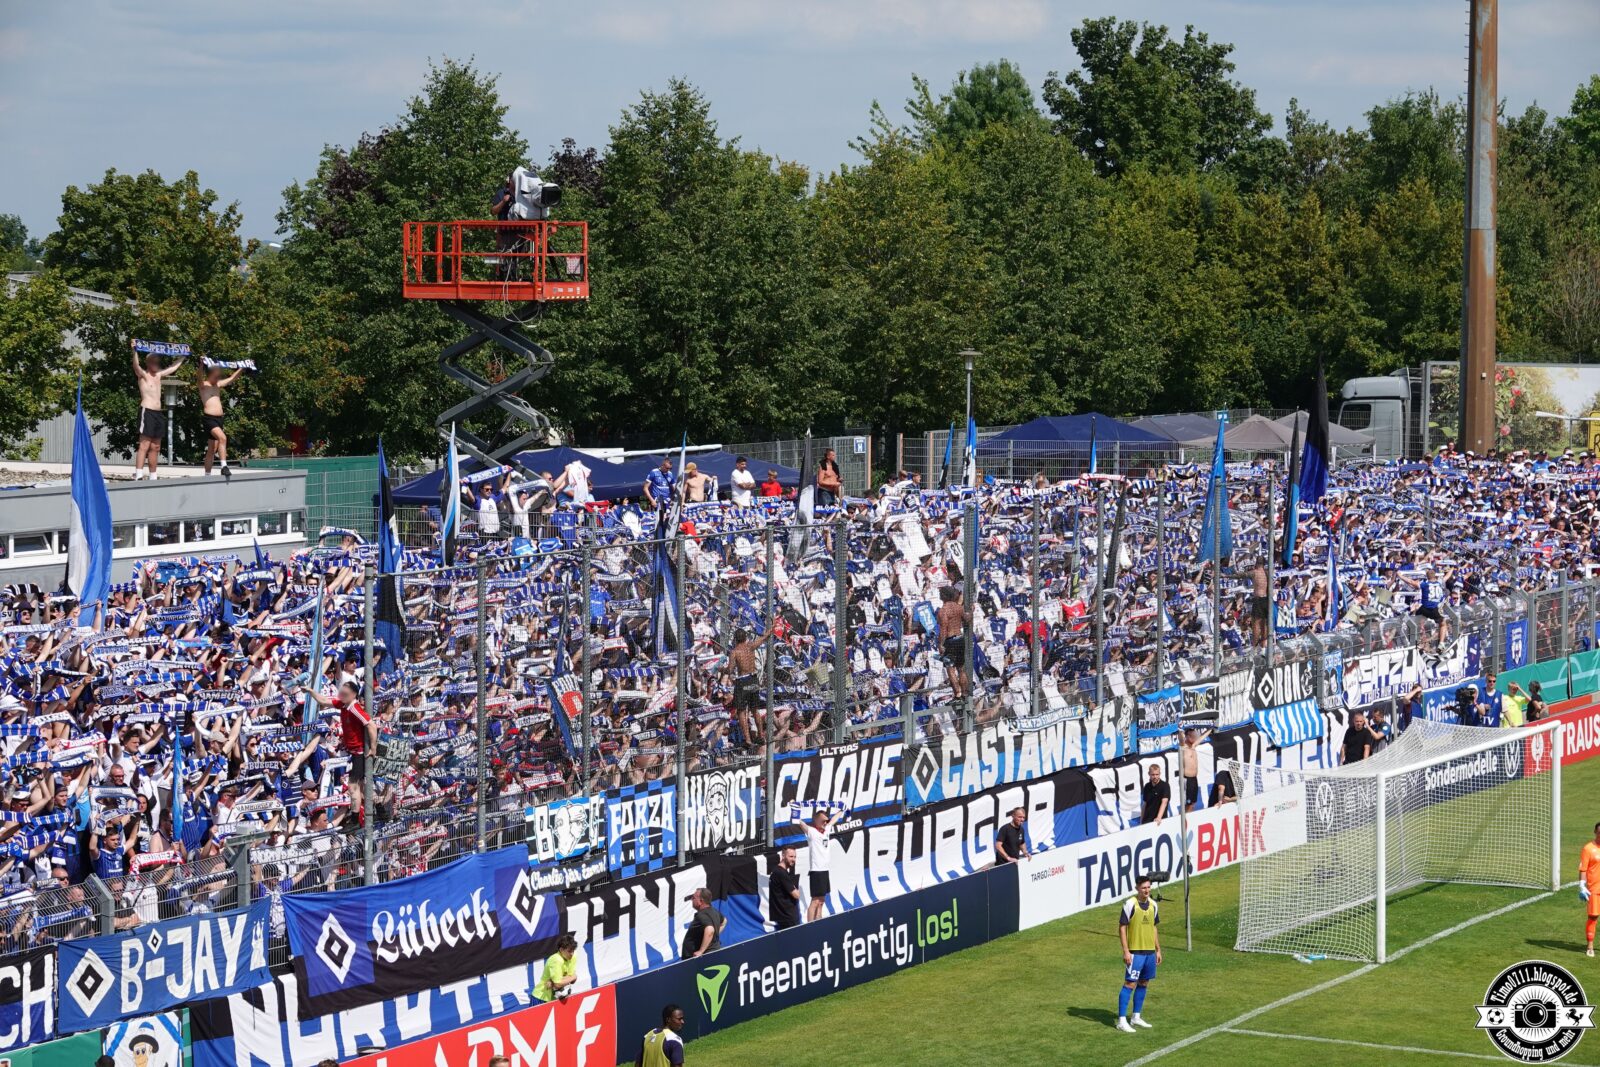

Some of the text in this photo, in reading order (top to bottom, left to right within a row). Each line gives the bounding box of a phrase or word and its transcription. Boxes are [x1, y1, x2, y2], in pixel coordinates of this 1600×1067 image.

[774, 742, 904, 824] CLIQUE
[819, 743, 859, 757] ULTRAS
[941, 701, 1118, 798] CASTAWAYS
[1424, 749, 1498, 792] Sondermodelle
[608, 791, 675, 847] FORZA
[836, 818, 863, 833] NORD
[371, 886, 498, 964] Lübeck
[737, 897, 961, 1007] freenet, fertig, los!
